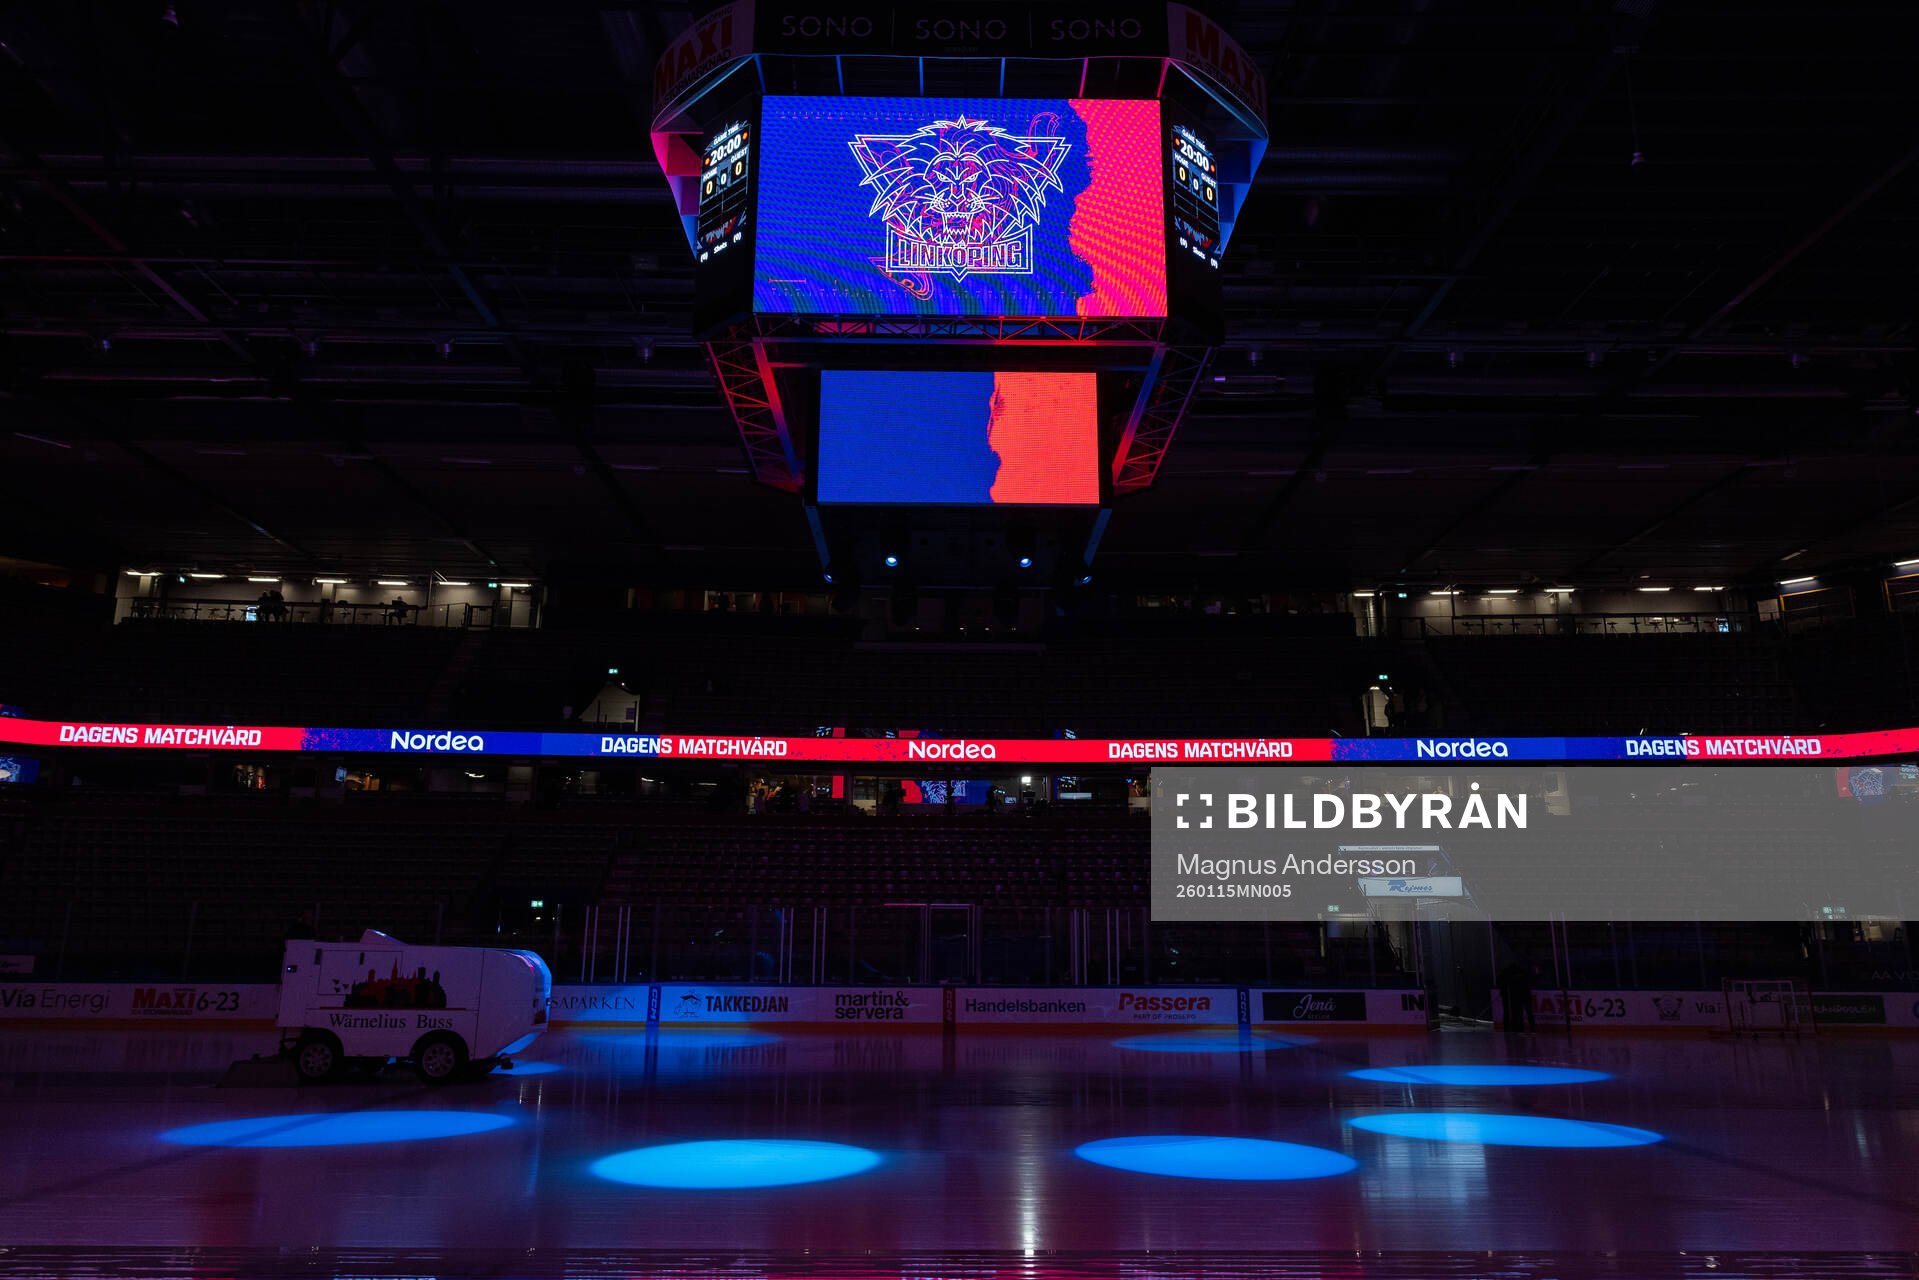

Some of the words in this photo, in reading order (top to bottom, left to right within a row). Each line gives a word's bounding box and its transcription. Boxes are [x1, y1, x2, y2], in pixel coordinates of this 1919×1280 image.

[781, 15, 874, 38] SONO
[913, 17, 1008, 41] SONO
[1049, 17, 1143, 41] SONO
[655, 15, 733, 101] MAXI
[709, 133, 742, 167] 20:00
[1180, 139, 1210, 172] 20:00
[735, 161, 742, 176] 0
[1179, 166, 1186, 181] 0
[706, 181, 713, 195] 0
[720, 173, 727, 185] 0
[1193, 177, 1199, 190] 0
[1206, 186, 1213, 201] 0
[898, 239, 1022, 268] LINKÖPING
[59, 725, 138, 744] DAGENS
[144, 725, 261, 746] MATCHVÄRD
[390, 730, 484, 752] Nordea
[1625, 739, 1700, 756] DAGENS
[1705, 735, 1822, 755] MATCHVÄRD
[601, 736, 673, 754] DAGENS
[678, 736, 787, 756] MATCHVÄRD
[908, 739, 996, 759] Nordea
[1108, 742, 1178, 758] DAGENS
[1184, 738, 1293, 759] MATCHVÄRD
[1416, 738, 1509, 757] Nordea
[1, 988, 35, 1008] Via
[41, 988, 112, 1014] Energi
[132, 988, 196, 1009] MAXI
[196, 992, 240, 1012] 6-23
[648, 987, 659, 1020] CCM
[705, 996, 789, 1013] TAKKEDJAN
[965, 998, 1087, 1013] Handelsbanken
[1118, 992, 1212, 1011] Passera
[1584, 998, 1627, 1018] 6-23
[1695, 1001, 1716, 1014] Via
[328, 1013, 407, 1029] Wärnelius
[416, 1014, 454, 1029] Buss
[834, 1006, 904, 1020] servera
